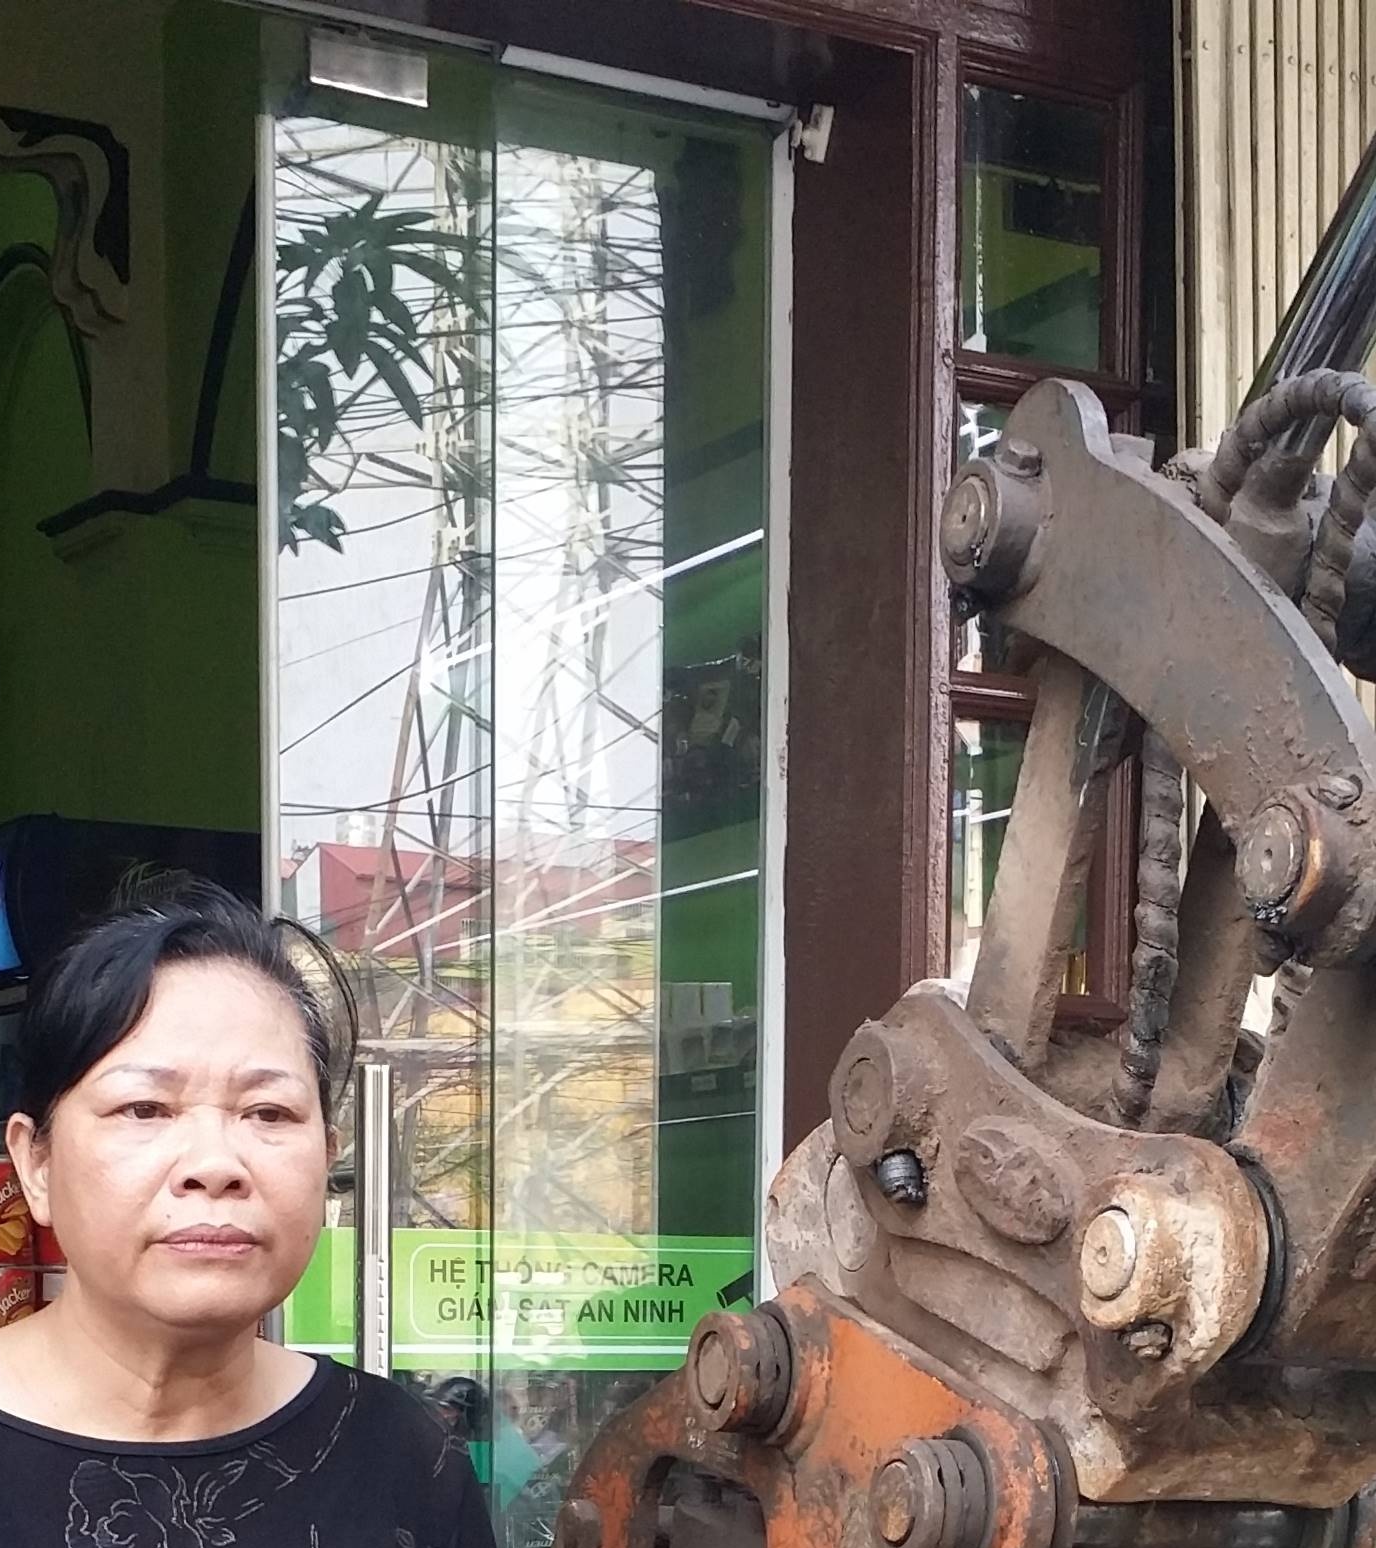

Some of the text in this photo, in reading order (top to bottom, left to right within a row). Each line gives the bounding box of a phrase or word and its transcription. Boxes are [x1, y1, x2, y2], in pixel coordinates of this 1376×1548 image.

[430, 1258, 466, 1290] HỆ
[582, 1261, 694, 1288] CAMERA
[577, 1299, 614, 1323] AN
[623, 1300, 684, 1324] NINH
